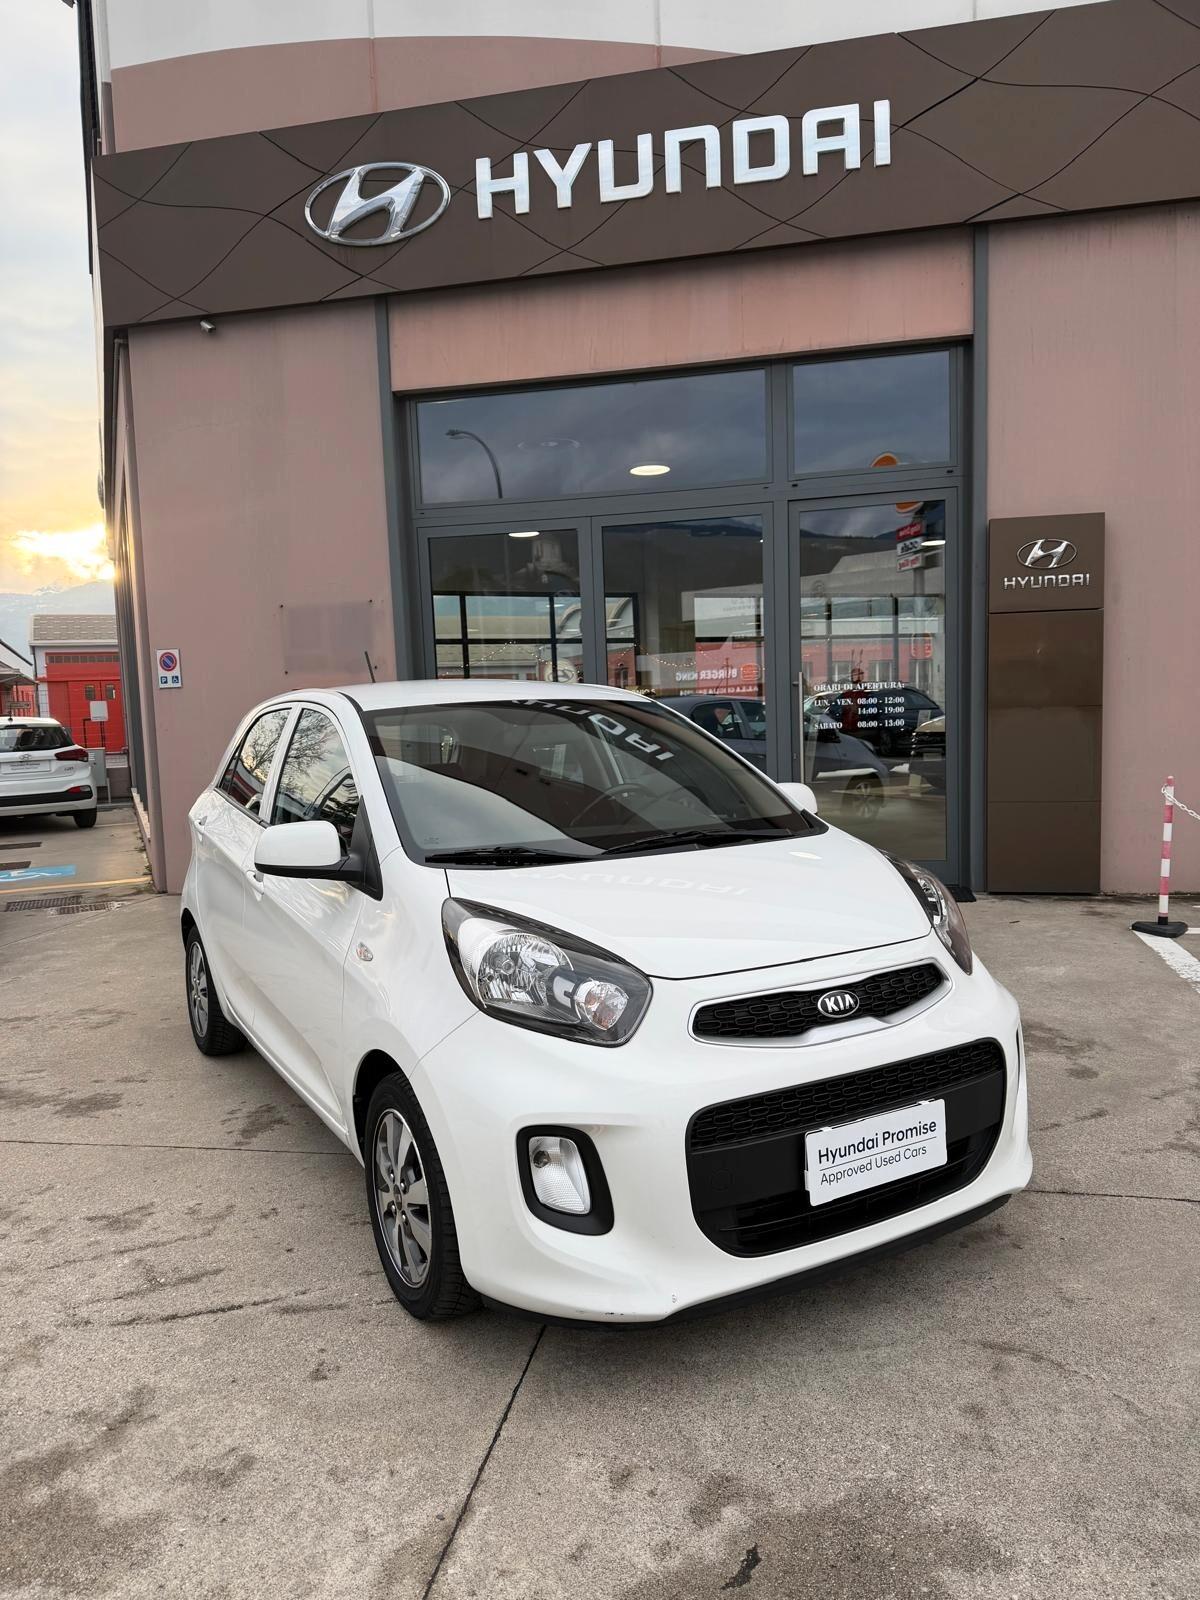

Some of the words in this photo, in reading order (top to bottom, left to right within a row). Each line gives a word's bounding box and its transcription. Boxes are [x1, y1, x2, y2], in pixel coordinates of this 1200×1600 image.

[475, 100, 890, 219] HYUNDAI
[1004, 573, 1090, 589] HYUNDAI
[813, 683, 841, 691] ORARI
[855, 681, 905, 690] APERTURA:
[857, 697, 878, 705] 08:00
[884, 696, 905, 704] 12:00
[857, 707, 878, 715] 14:00
[884, 706, 905, 714] 19:00
[814, 722, 843, 730] SABATO
[857, 720, 878, 728] 08:00
[884, 719, 905, 727] 13:00
[824, 991, 855, 1012] KIA
[818, 1133, 879, 1165] Hyundai
[883, 1120, 937, 1146] Promise
[820, 1159, 873, 1185] Approved
[875, 1151, 901, 1173] Used
[903, 1145, 927, 1160] Cars
